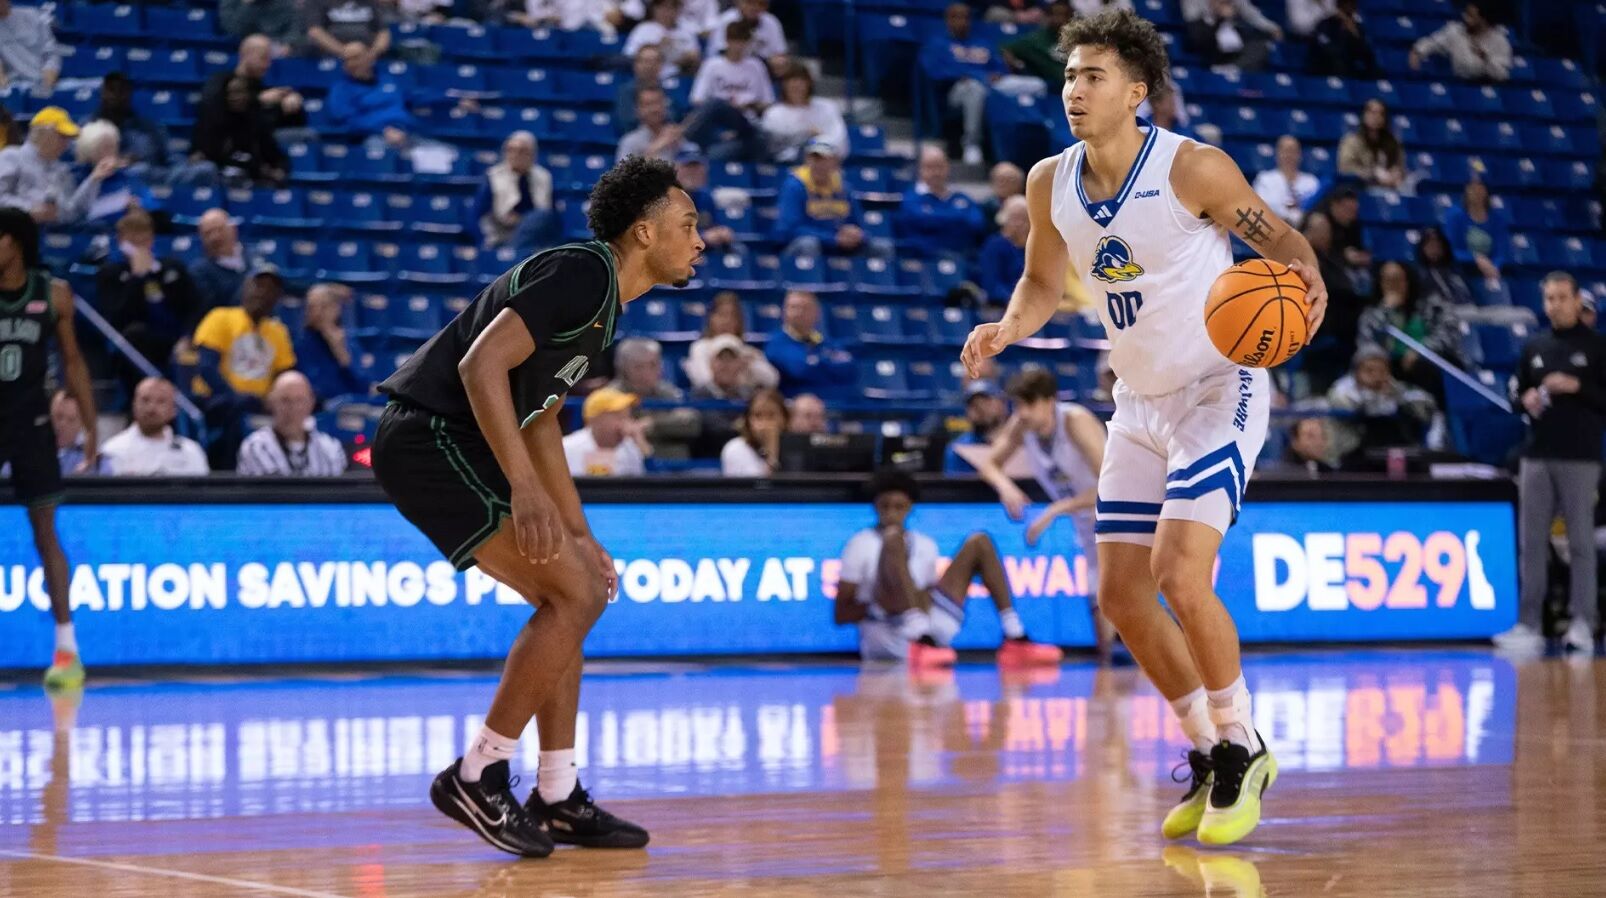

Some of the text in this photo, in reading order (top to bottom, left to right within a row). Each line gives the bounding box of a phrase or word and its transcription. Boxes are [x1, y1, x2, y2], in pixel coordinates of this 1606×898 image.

[237, 560, 458, 608] SAVINGS
[614, 557, 751, 603] ODAY
[756, 556, 815, 601] AT
[1252, 530, 1467, 612] DE529
